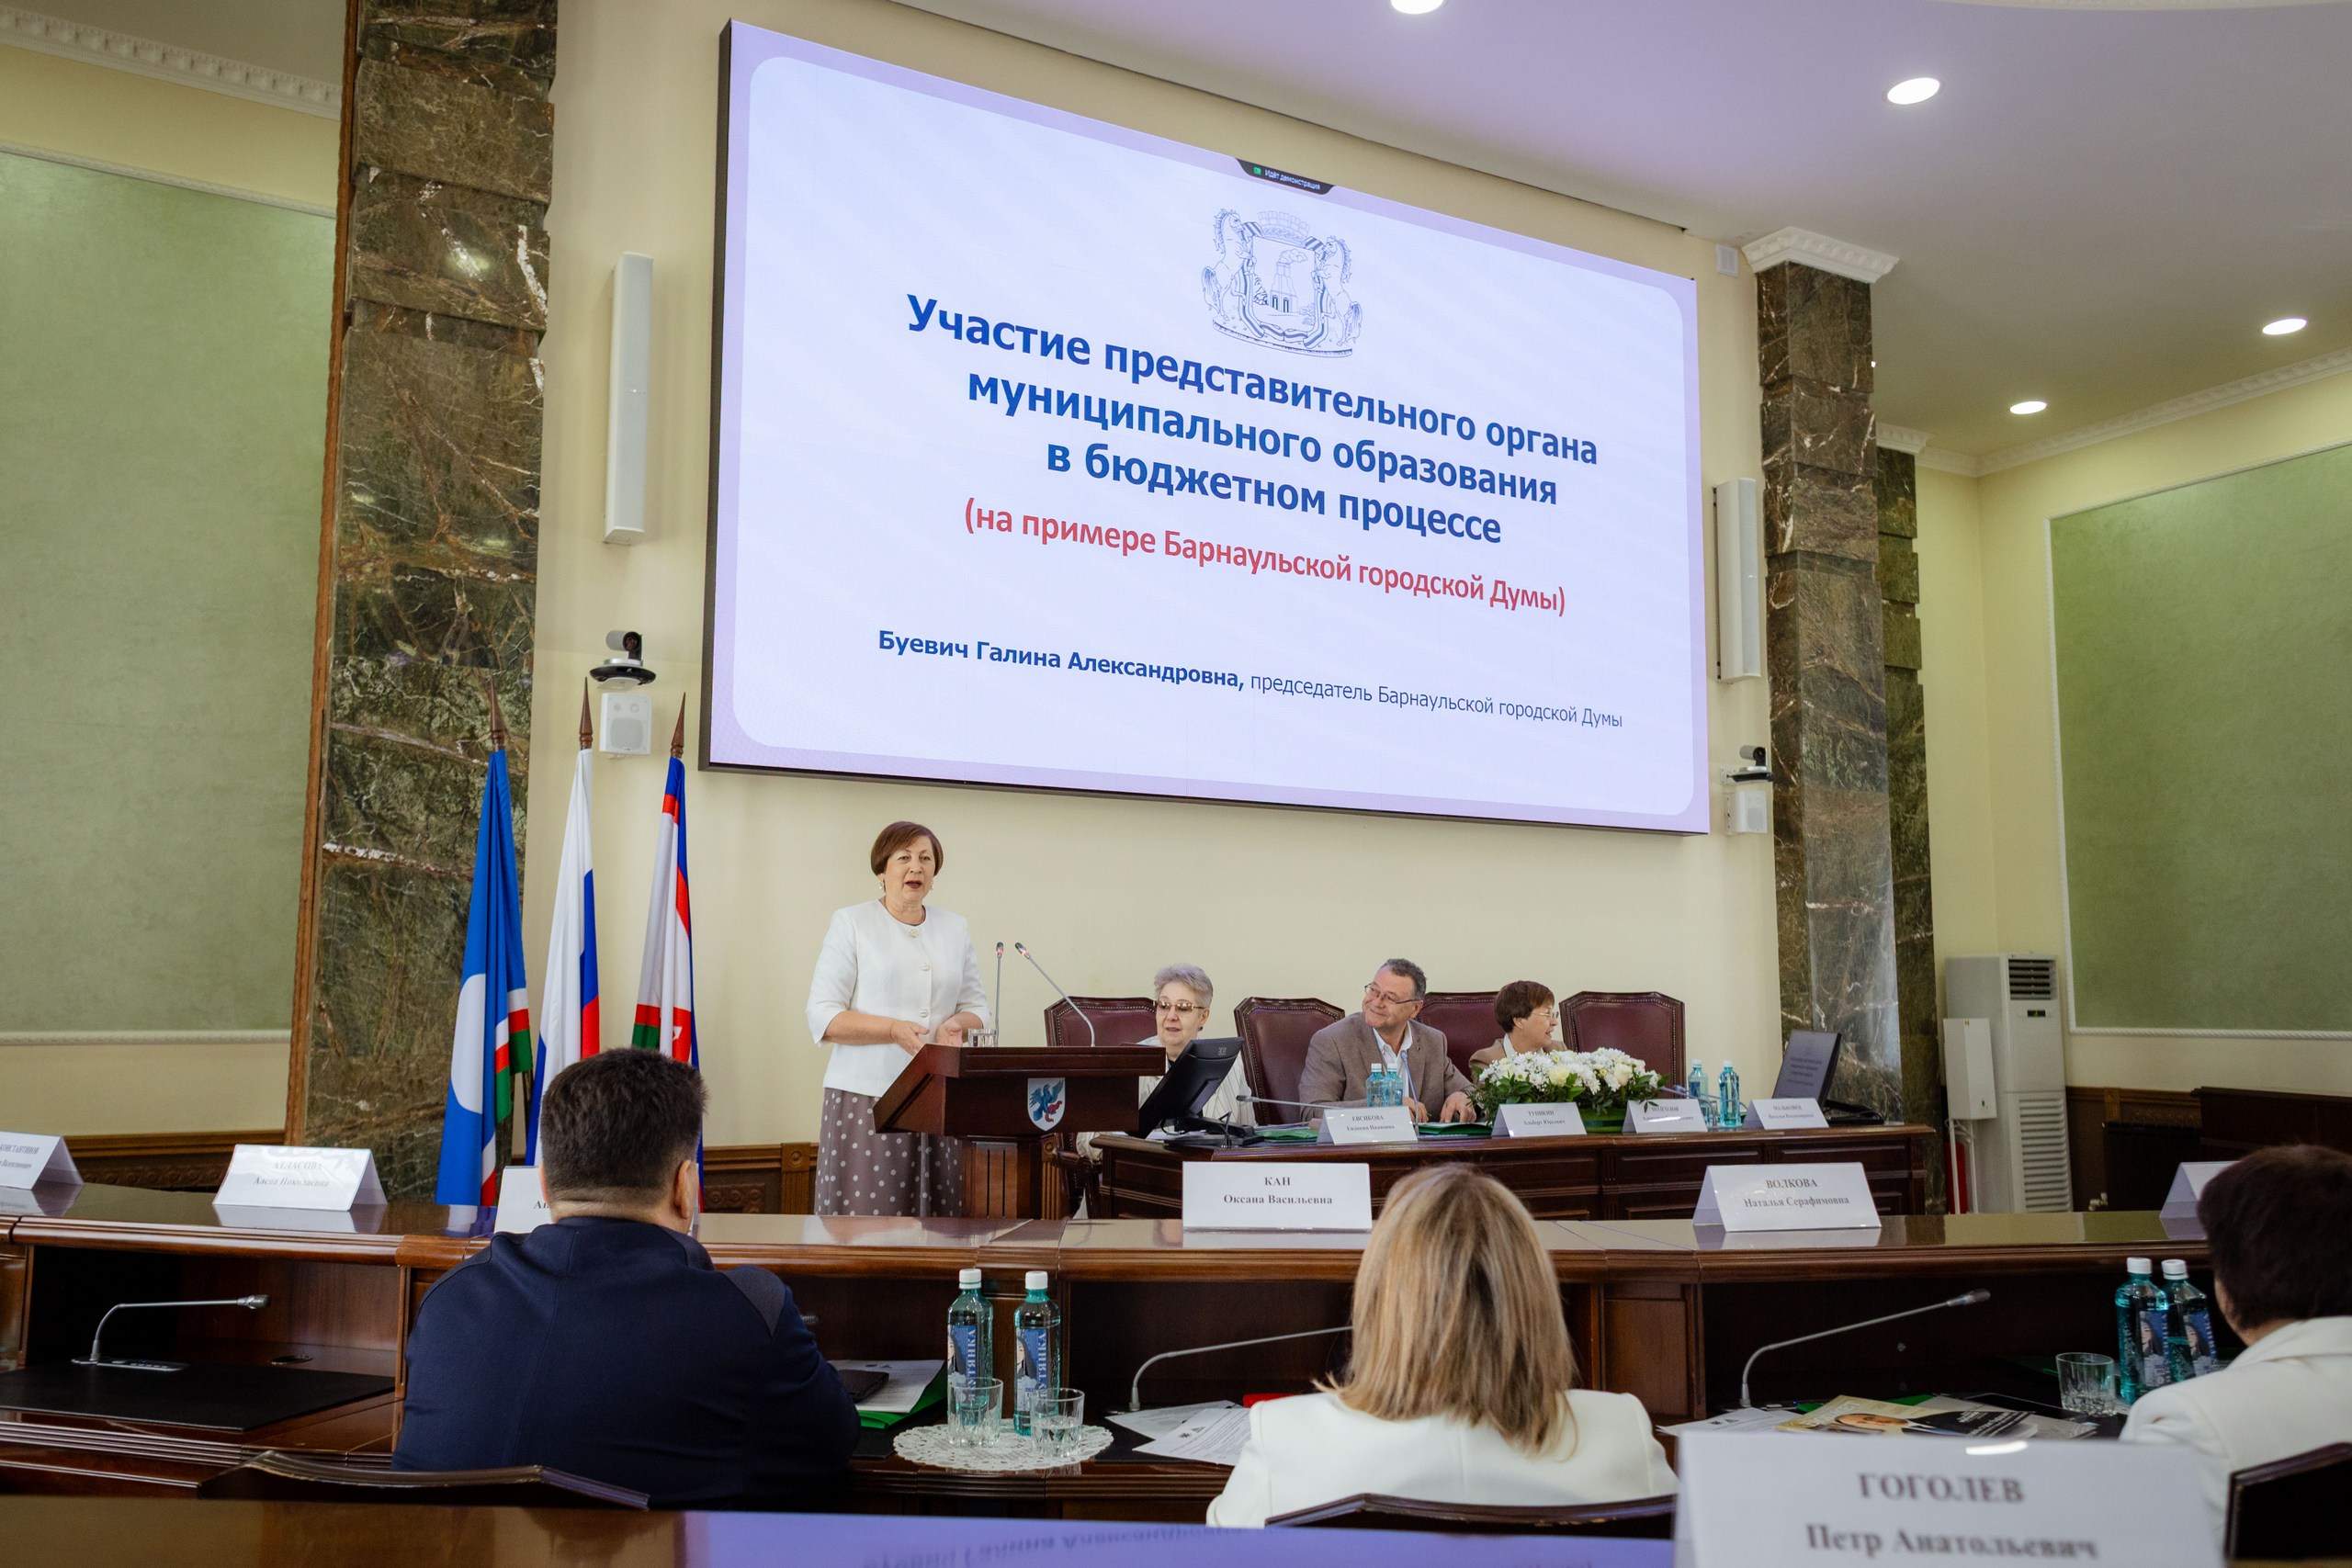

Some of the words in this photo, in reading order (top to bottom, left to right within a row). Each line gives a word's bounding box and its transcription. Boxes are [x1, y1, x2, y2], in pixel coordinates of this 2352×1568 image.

[907, 293, 1091, 366] Участие
[1104, 344, 1476, 441] представительного
[1486, 421, 1598, 466] органа
[968, 373, 1322, 463] муниципального
[1332, 438, 1557, 505] образования
[1047, 444, 1071, 472] в
[1085, 443, 1326, 515] бюджетном
[1339, 494, 1502, 544] процессе
[965, 497, 1012, 534] (на
[1023, 514, 1156, 557] примере
[1164, 530, 1351, 581] Барнаульской
[1358, 564, 1484, 600] городской
[1489, 579, 1566, 617] Думы)
[878, 629, 968, 659] Буевич
[977, 640, 1061, 669] Галина
[1067, 651, 1245, 692] Александровна,
[1250, 674, 1373, 702] председатель
[1378, 685, 1494, 715] Барнаульской
[1498, 701, 1577, 722] городской
[1581, 707, 1623, 728] Думы
[279, 1177, 330, 1188] Николаевна
[1223, 1193, 1265, 1205] Оксана
[1268, 1195, 1333, 1205] Васильевна
[1264, 1177, 1292, 1187] КАН
[1766, 1178, 1818, 1190] ВОЛКОВА
[1745, 1197, 1784, 1208] Наталья
[1786, 1196, 1850, 1210] Серафимовна
[1858, 1472, 2025, 1504] ГОГОЛЕВ
[1805, 1523, 1883, 1559] Петр
[1892, 1529, 2099, 1560] Анатольевич
